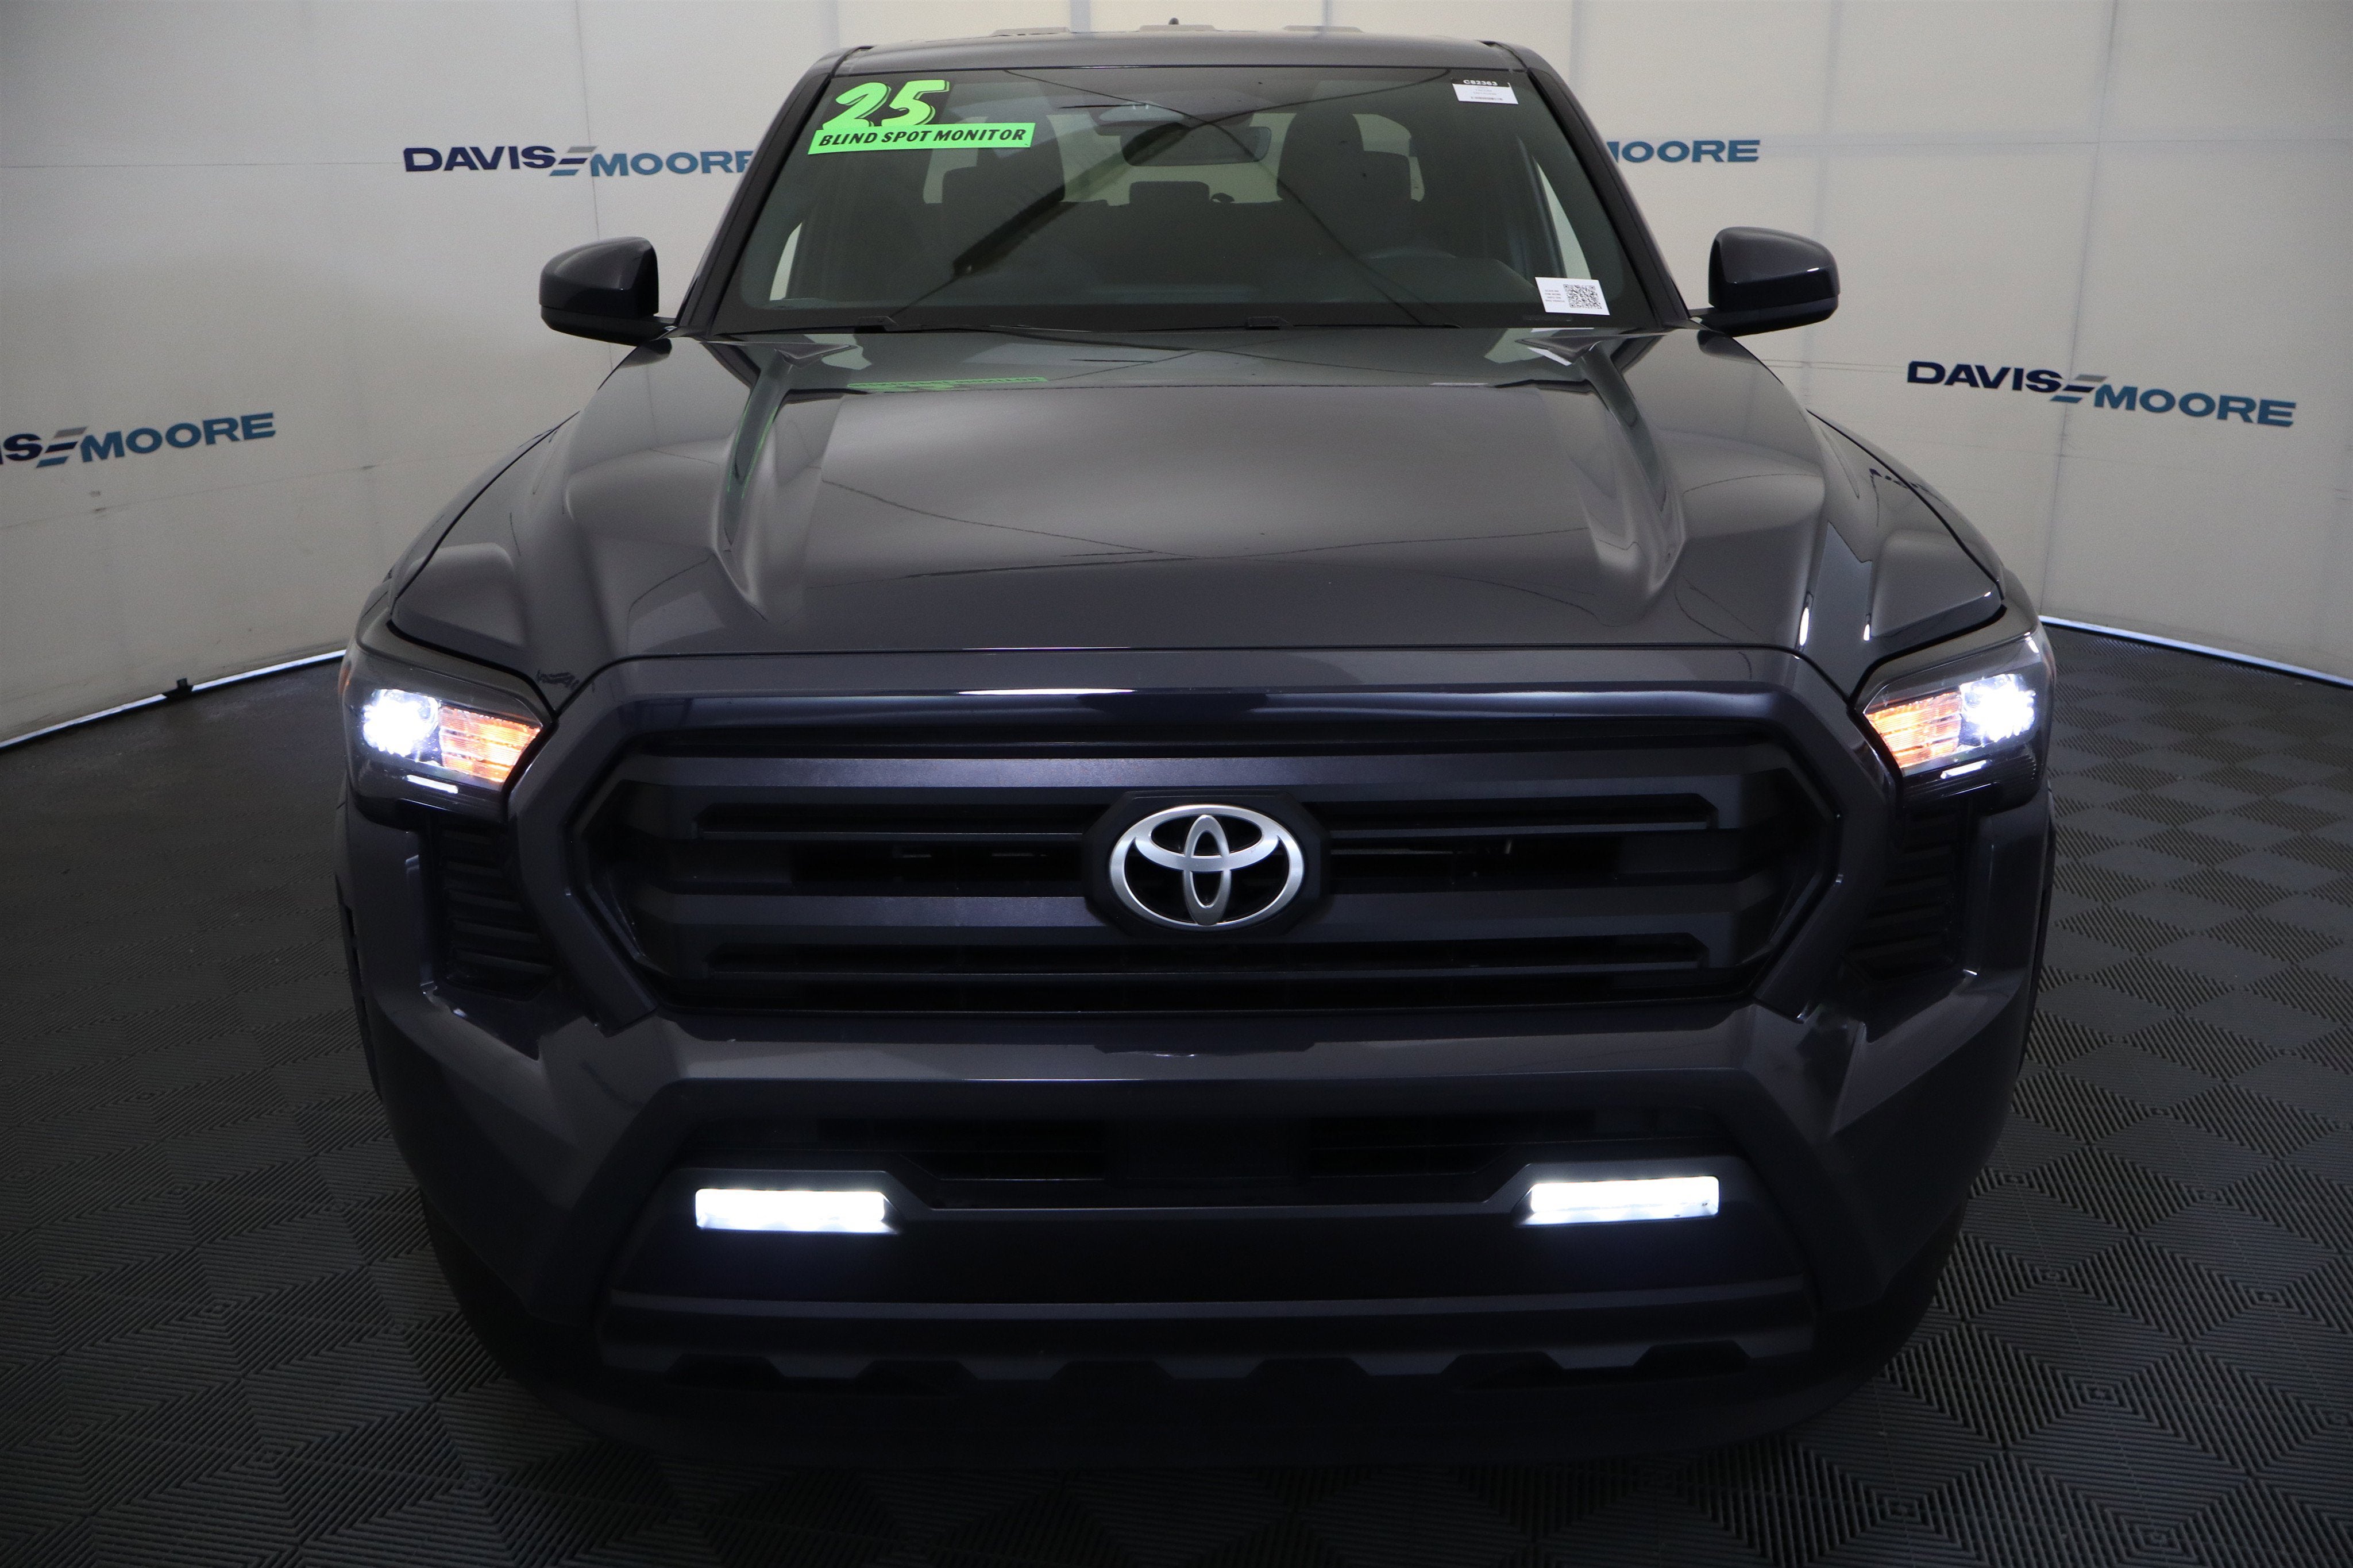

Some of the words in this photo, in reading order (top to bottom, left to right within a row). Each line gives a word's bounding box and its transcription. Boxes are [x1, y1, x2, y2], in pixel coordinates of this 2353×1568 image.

[822, 79, 950, 130] 25
[403, 146, 557, 172] DAVIS
[818, 132, 878, 146] BLIND
[881, 130, 931, 142] SPOT
[934, 128, 1027, 141] MONITOR
[1907, 361, 2063, 393] DAVIS
[2093, 384, 2297, 427] MOORE
[80, 412, 276, 463] MOORE
